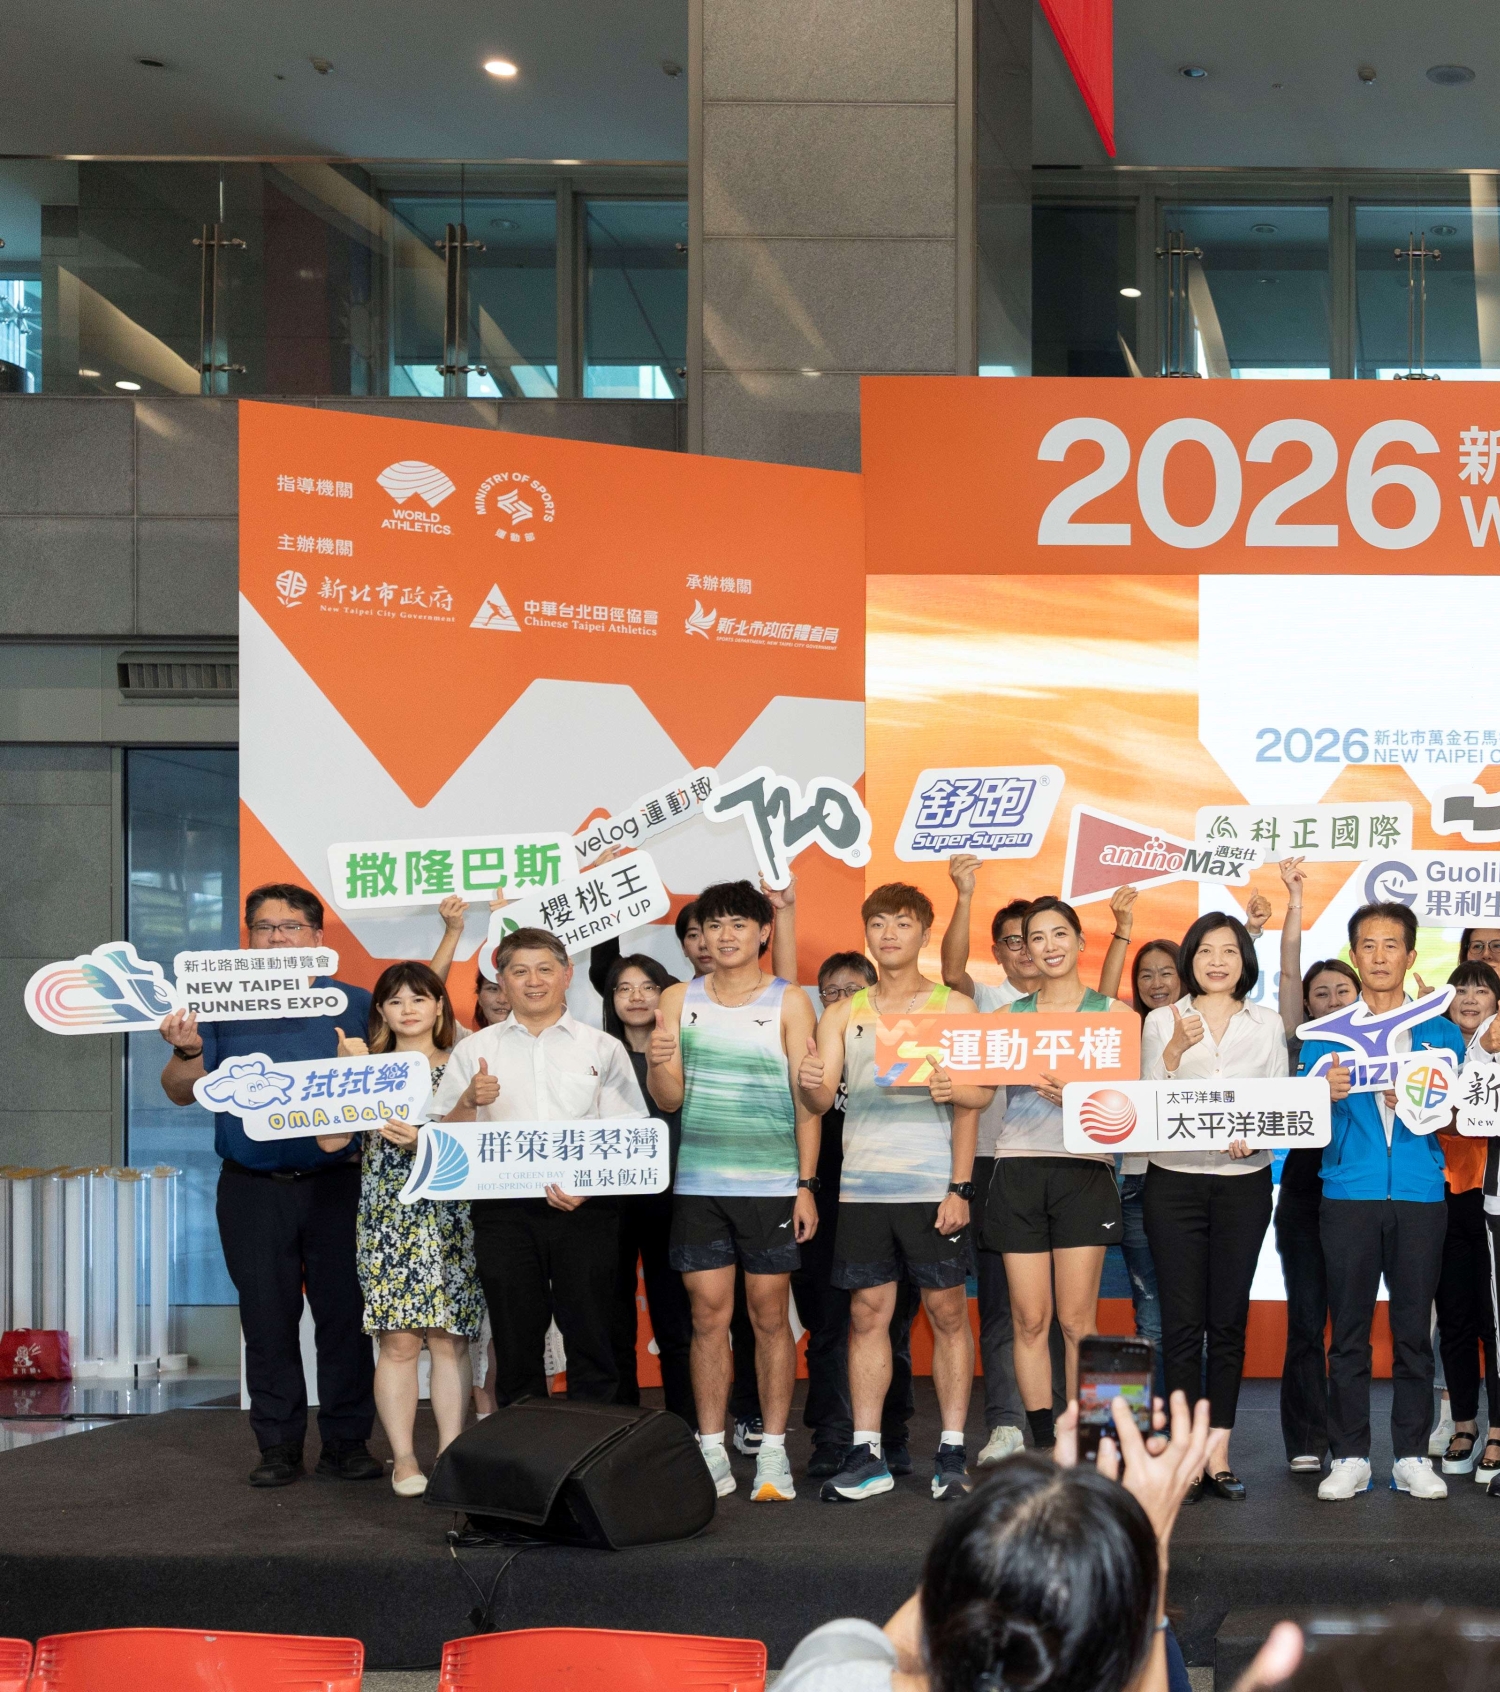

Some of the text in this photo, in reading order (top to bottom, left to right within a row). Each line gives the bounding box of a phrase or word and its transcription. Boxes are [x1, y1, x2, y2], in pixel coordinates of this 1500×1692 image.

[277, 474, 353, 499] 指導機關
[1037, 417, 1441, 550] 2026
[475, 472, 555, 523] MINISTRY OF SPORTS
[381, 518, 451, 536] ATHLETICS
[392, 508, 441, 523] WORLD
[277, 533, 353, 557] 主辦機關
[316, 576, 454, 612] 新北市政府
[685, 573, 752, 595] 承辦機關
[320, 605, 456, 623] New Taipei City Government
[523, 600, 659, 626] 中華台北田徑協會
[524, 616, 658, 636] Chinese Taipei Athletics
[1255, 728, 1369, 765] 2026
[1374, 747, 1421, 764] NEW
[1426, 747, 1484, 764] TAIPEI
[915, 777, 1037, 829] 舒跑
[1249, 813, 1402, 851] 科正國際
[1100, 840, 1245, 879] aminoMax
[1214, 843, 1257, 863] 邁克仕
[345, 842, 562, 899] 撒隆巴斯
[539, 864, 648, 931] 櫻桃王
[628, 899, 651, 918] UP
[183, 954, 331, 974] 新北路跑運動博覽會
[186, 978, 300, 995] NEW TAIPEI
[189, 994, 339, 1014] RUNNERS EXPO
[938, 1026, 1122, 1071] 運動平權
[1166, 1090, 1236, 1105] 太平洋集團
[268, 1108, 331, 1130] OMA
[344, 1101, 410, 1122] Baby
[1166, 1110, 1315, 1140] 太平洋建設
[1467, 1117, 1494, 1127] New
[477, 1127, 659, 1163] 群策翡翠灣
[498, 1170, 566, 1179] CT GREEN BAY
[573, 1167, 659, 1188] 溫泉飯店
[477, 1182, 533, 1191] HOT-SPRING
